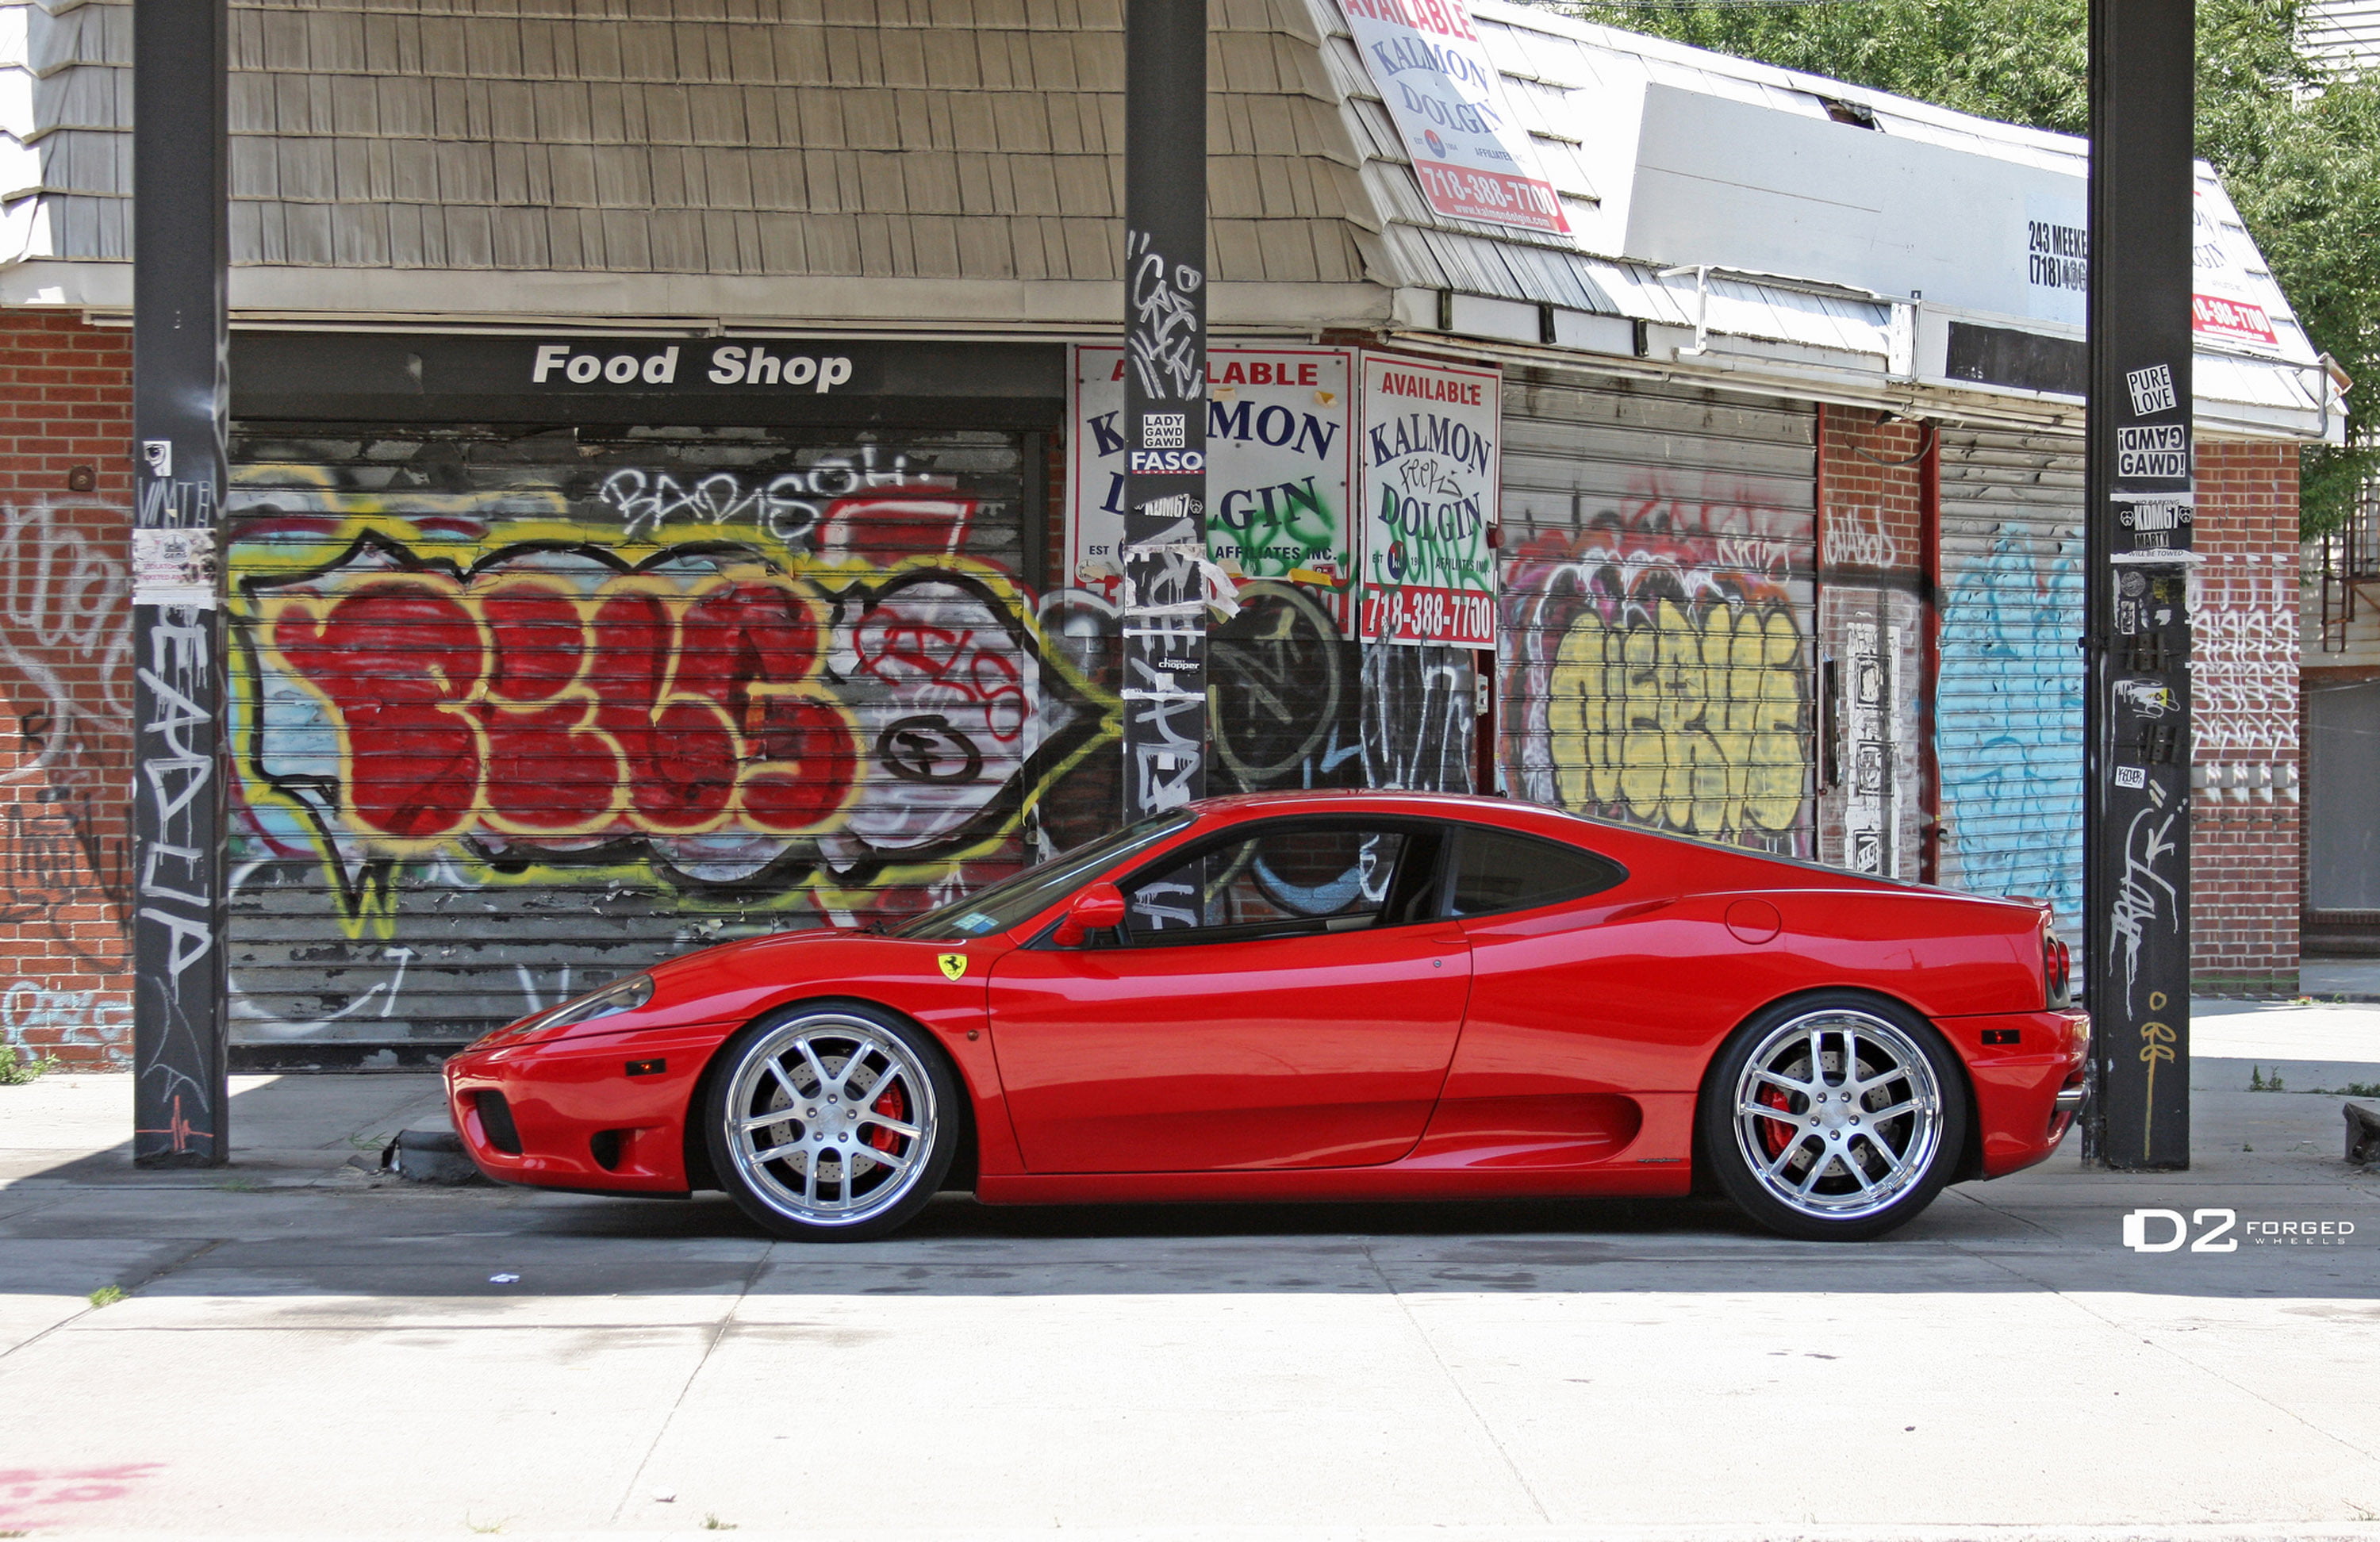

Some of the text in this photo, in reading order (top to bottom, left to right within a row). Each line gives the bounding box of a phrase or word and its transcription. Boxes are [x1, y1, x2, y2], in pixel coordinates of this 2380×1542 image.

[1371, 36, 1489, 94] KALMON
[1396, 79, 1504, 134] DOLGIN
[1422, 167, 1558, 217] 718-388-7700
[1453, 204, 1551, 227] www.kalmondolgin.com
[2029, 220, 2087, 259] 243 MEEKE
[2194, 298, 2270, 333] 18-388-7700
[533, 346, 853, 393] Food Shop
[1111, 359, 1318, 386] LABLE
[2129, 366, 2170, 393] PURE
[1382, 372, 1481, 407] AVAILABLE
[2134, 388, 2172, 415] LOVE
[1087, 398, 1340, 461] KMON
[1145, 416, 1183, 426] LADY
[1145, 428, 1183, 436] GAWD
[1145, 438, 1183, 447] GAWD
[1369, 413, 1491, 478] KALMON
[1131, 451, 1203, 470] FASO
[2120, 452, 2184, 476] GAWD!
[1100, 471, 1323, 531] DGIN
[1378, 482, 1482, 543] DOLGIN
[1089, 546, 1110, 555] EST
[1215, 546, 1337, 560] AFFILIATES INC.
[2136, 532, 2167, 548] MARTY
[1372, 554, 1383, 564] EST
[1368, 589, 1491, 639] 718-388-7700
[1158, 658, 1200, 670] chopper
